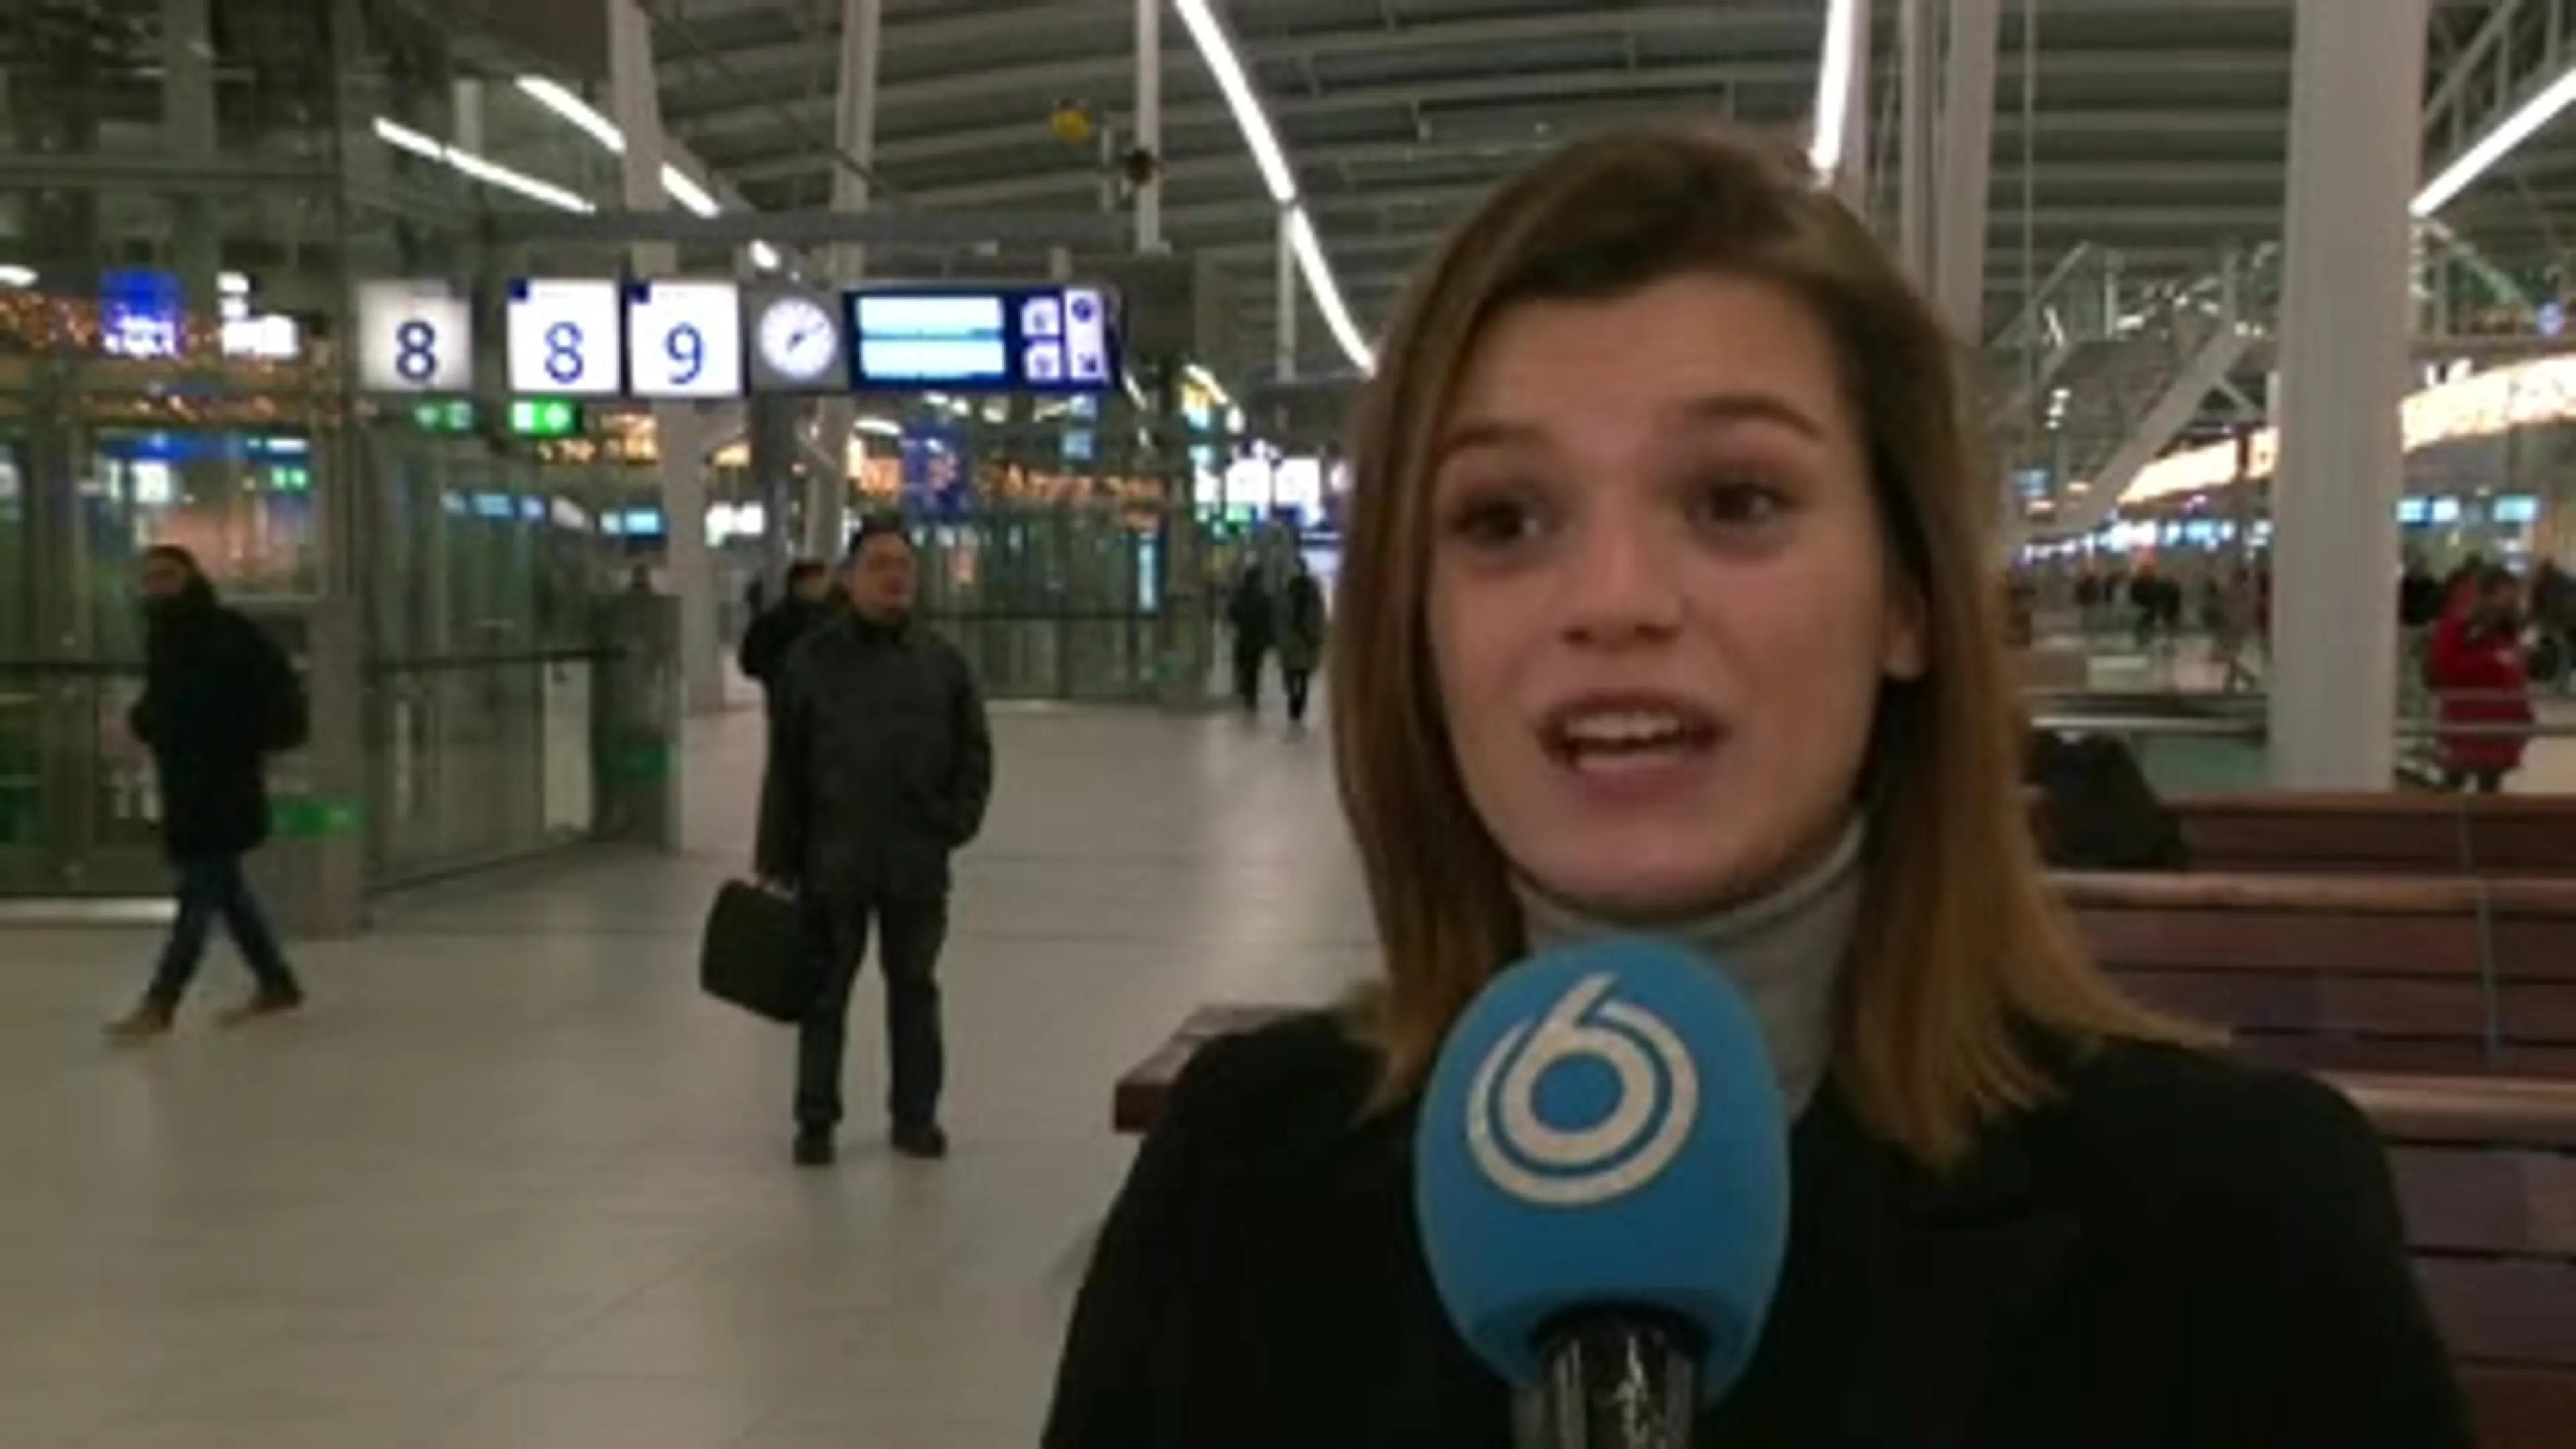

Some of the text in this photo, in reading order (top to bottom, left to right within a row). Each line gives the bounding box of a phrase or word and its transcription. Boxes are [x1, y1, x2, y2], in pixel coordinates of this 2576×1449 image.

[395, 320, 437, 382] 8
[544, 321, 584, 384] 8
[665, 323, 704, 385] 9
[1468, 972, 1699, 1205] 6
